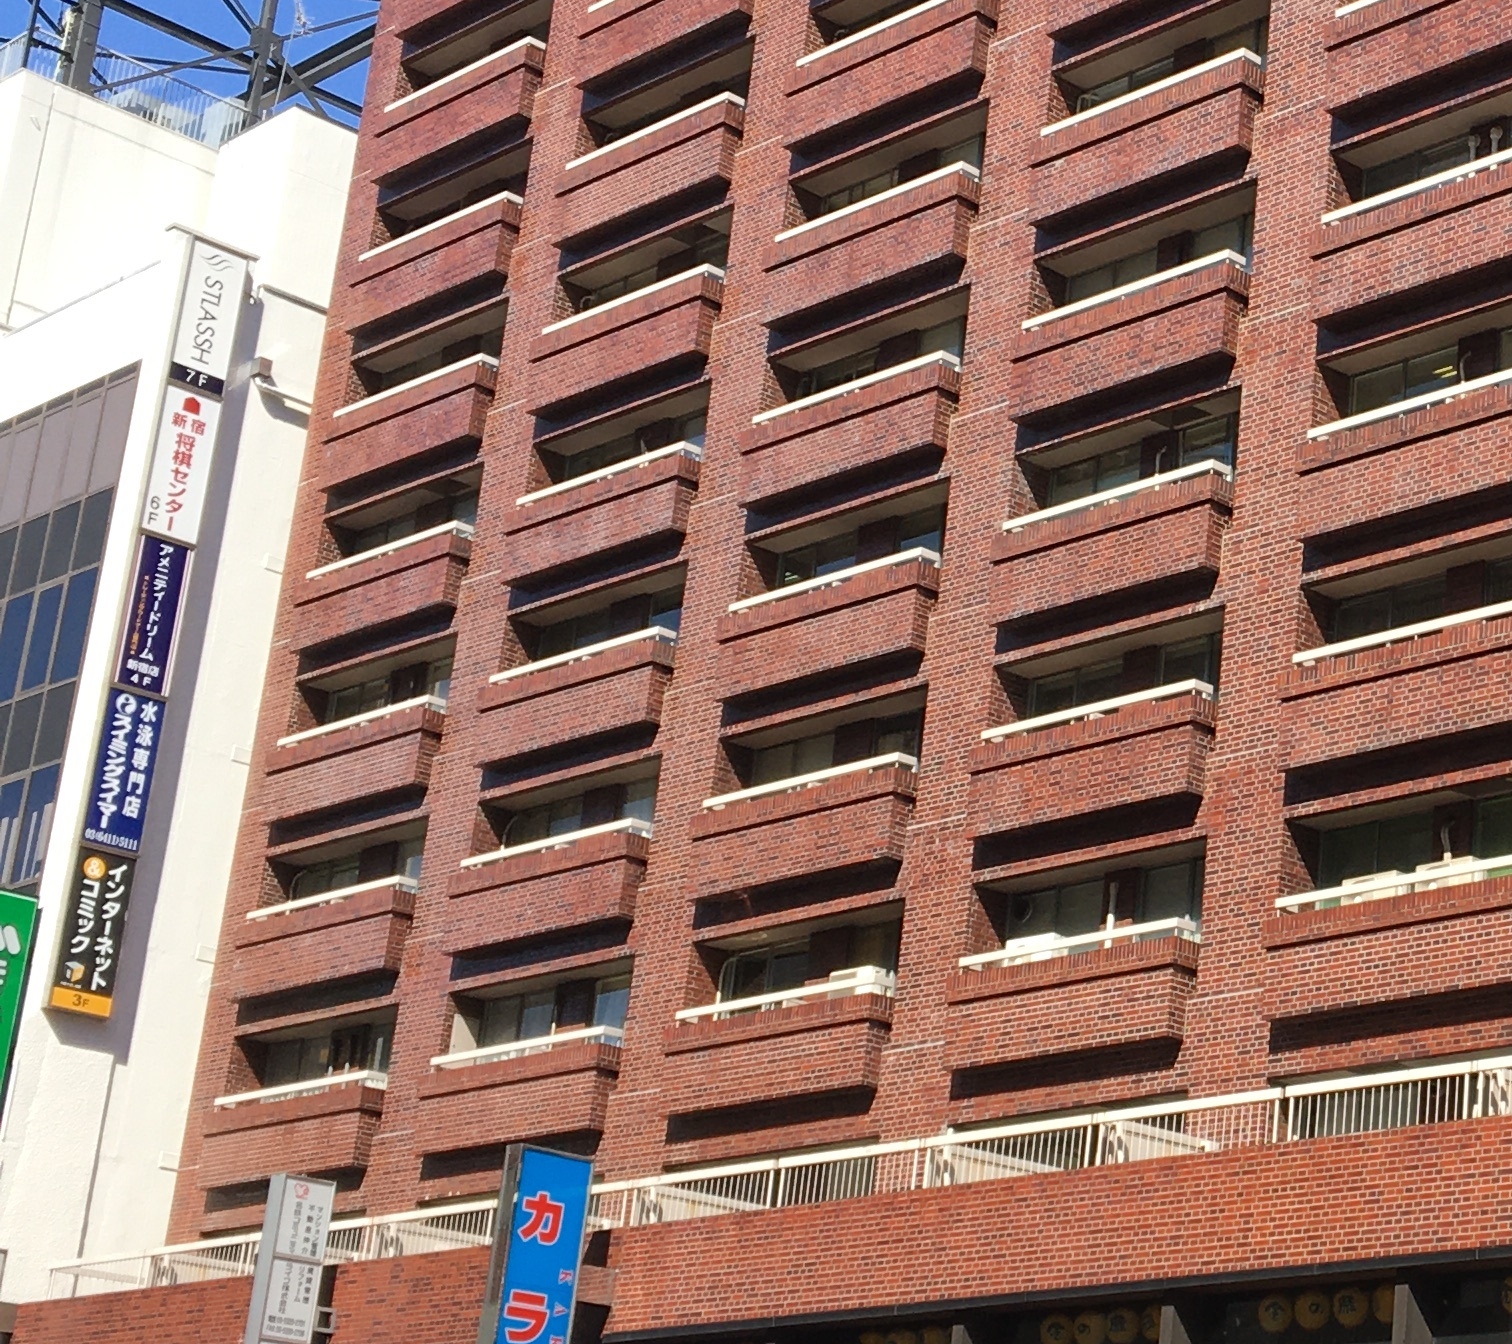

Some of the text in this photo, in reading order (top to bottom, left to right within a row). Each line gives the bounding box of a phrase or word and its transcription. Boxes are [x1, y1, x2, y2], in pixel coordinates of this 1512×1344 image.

[190, 275, 224, 365] STLASSH
[185, 369, 208, 387] 7F
[171, 411, 206, 437] 新宿
[164, 432, 196, 532] 将棋センター
[138, 543, 175, 662] アメニティードリーム
[126, 658, 160, 678] 新宿店
[96, 713, 132, 829] スイミングスイマー
[121, 701, 159, 820] 水泳専門店
[69, 879, 100, 955] コミック
[90, 864, 128, 991] インターネット
[72, 993, 90, 1008] 3F
